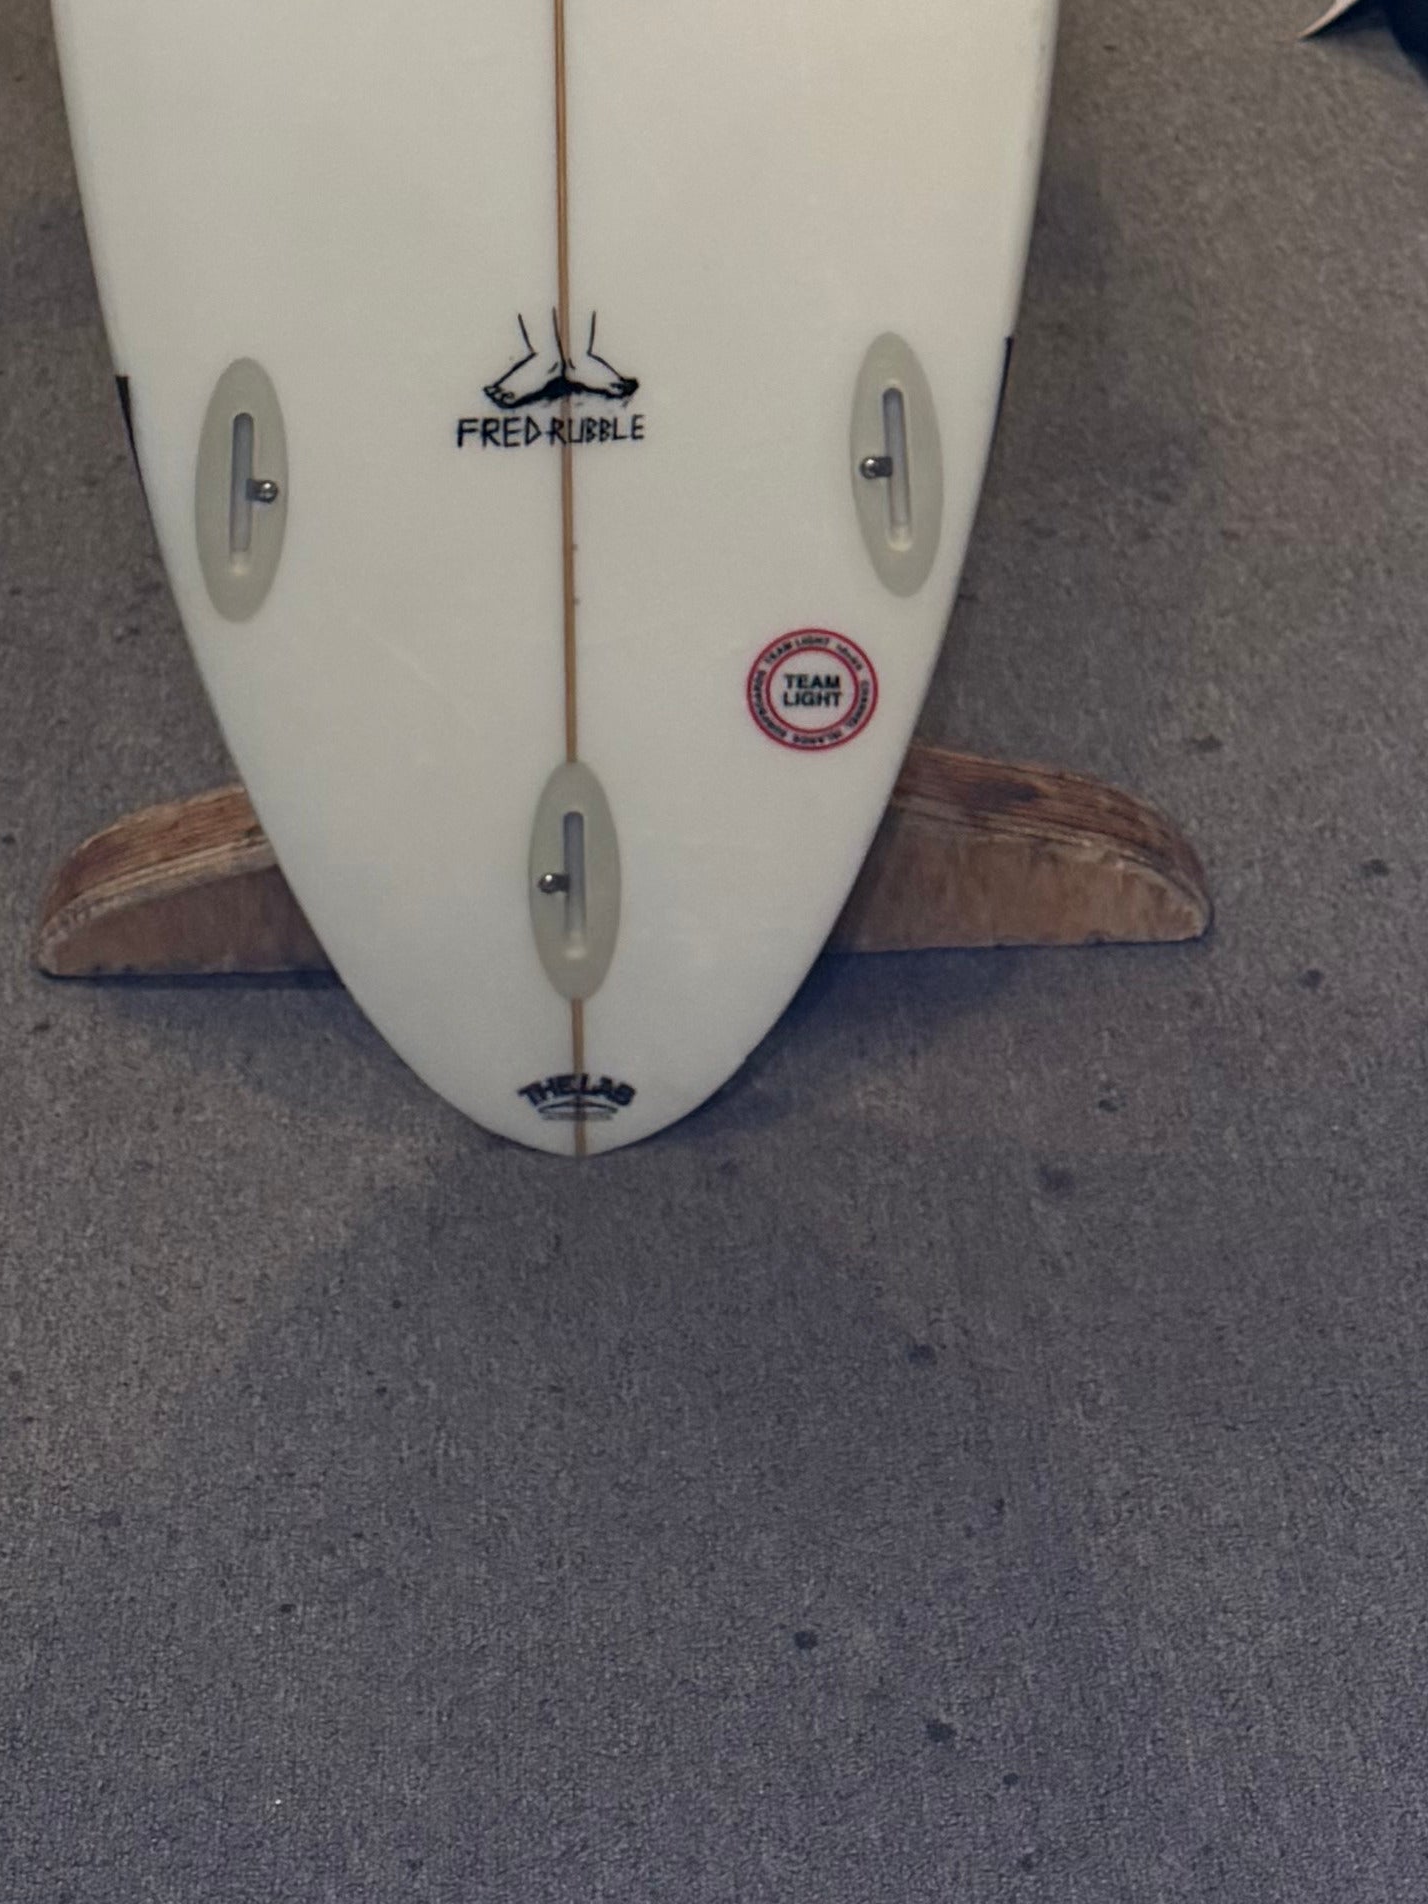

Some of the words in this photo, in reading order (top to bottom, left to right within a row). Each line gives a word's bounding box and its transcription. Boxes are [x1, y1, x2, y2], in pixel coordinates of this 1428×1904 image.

[457, 415, 542, 449] FRED
[548, 413, 646, 447] RUBBLE
[783, 673, 841, 690] TEAM
[782, 690, 843, 708] LIGHT
